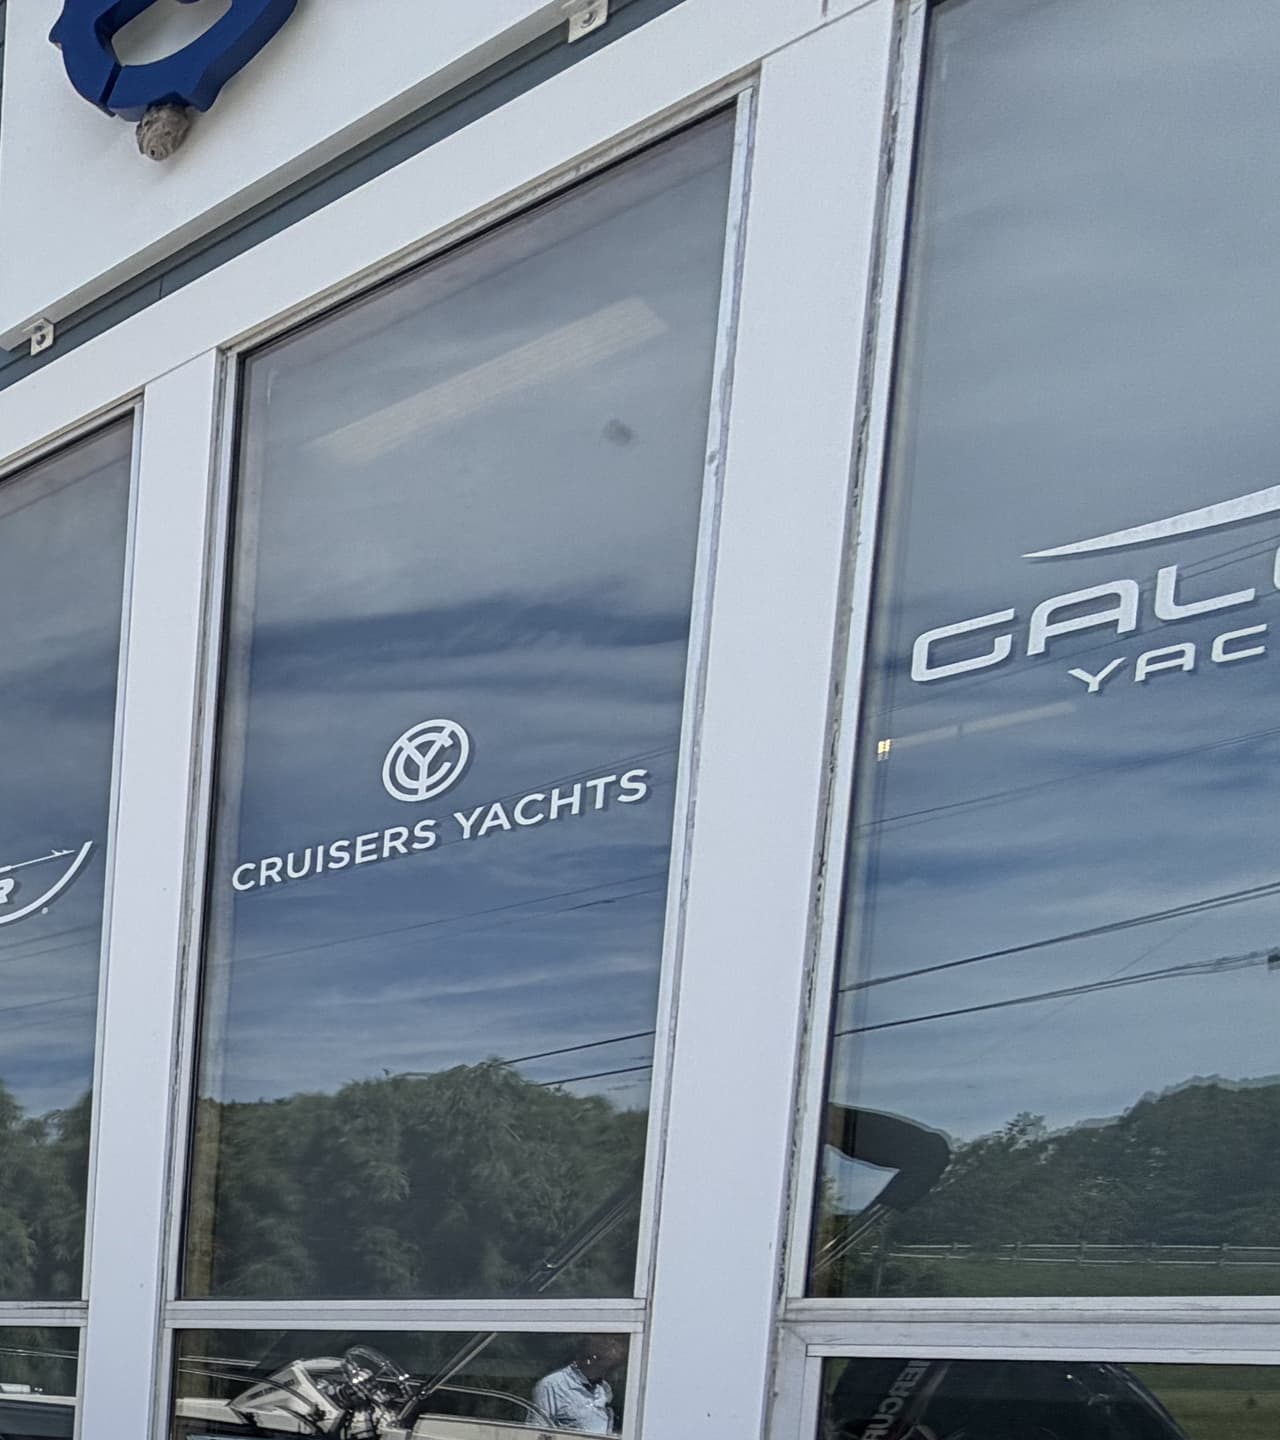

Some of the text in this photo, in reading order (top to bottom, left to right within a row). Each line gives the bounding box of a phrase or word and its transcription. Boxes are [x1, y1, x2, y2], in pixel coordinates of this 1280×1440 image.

[911, 548, 1280, 683] GAL
[232, 769, 648, 891] CRUISERS YACHTS
